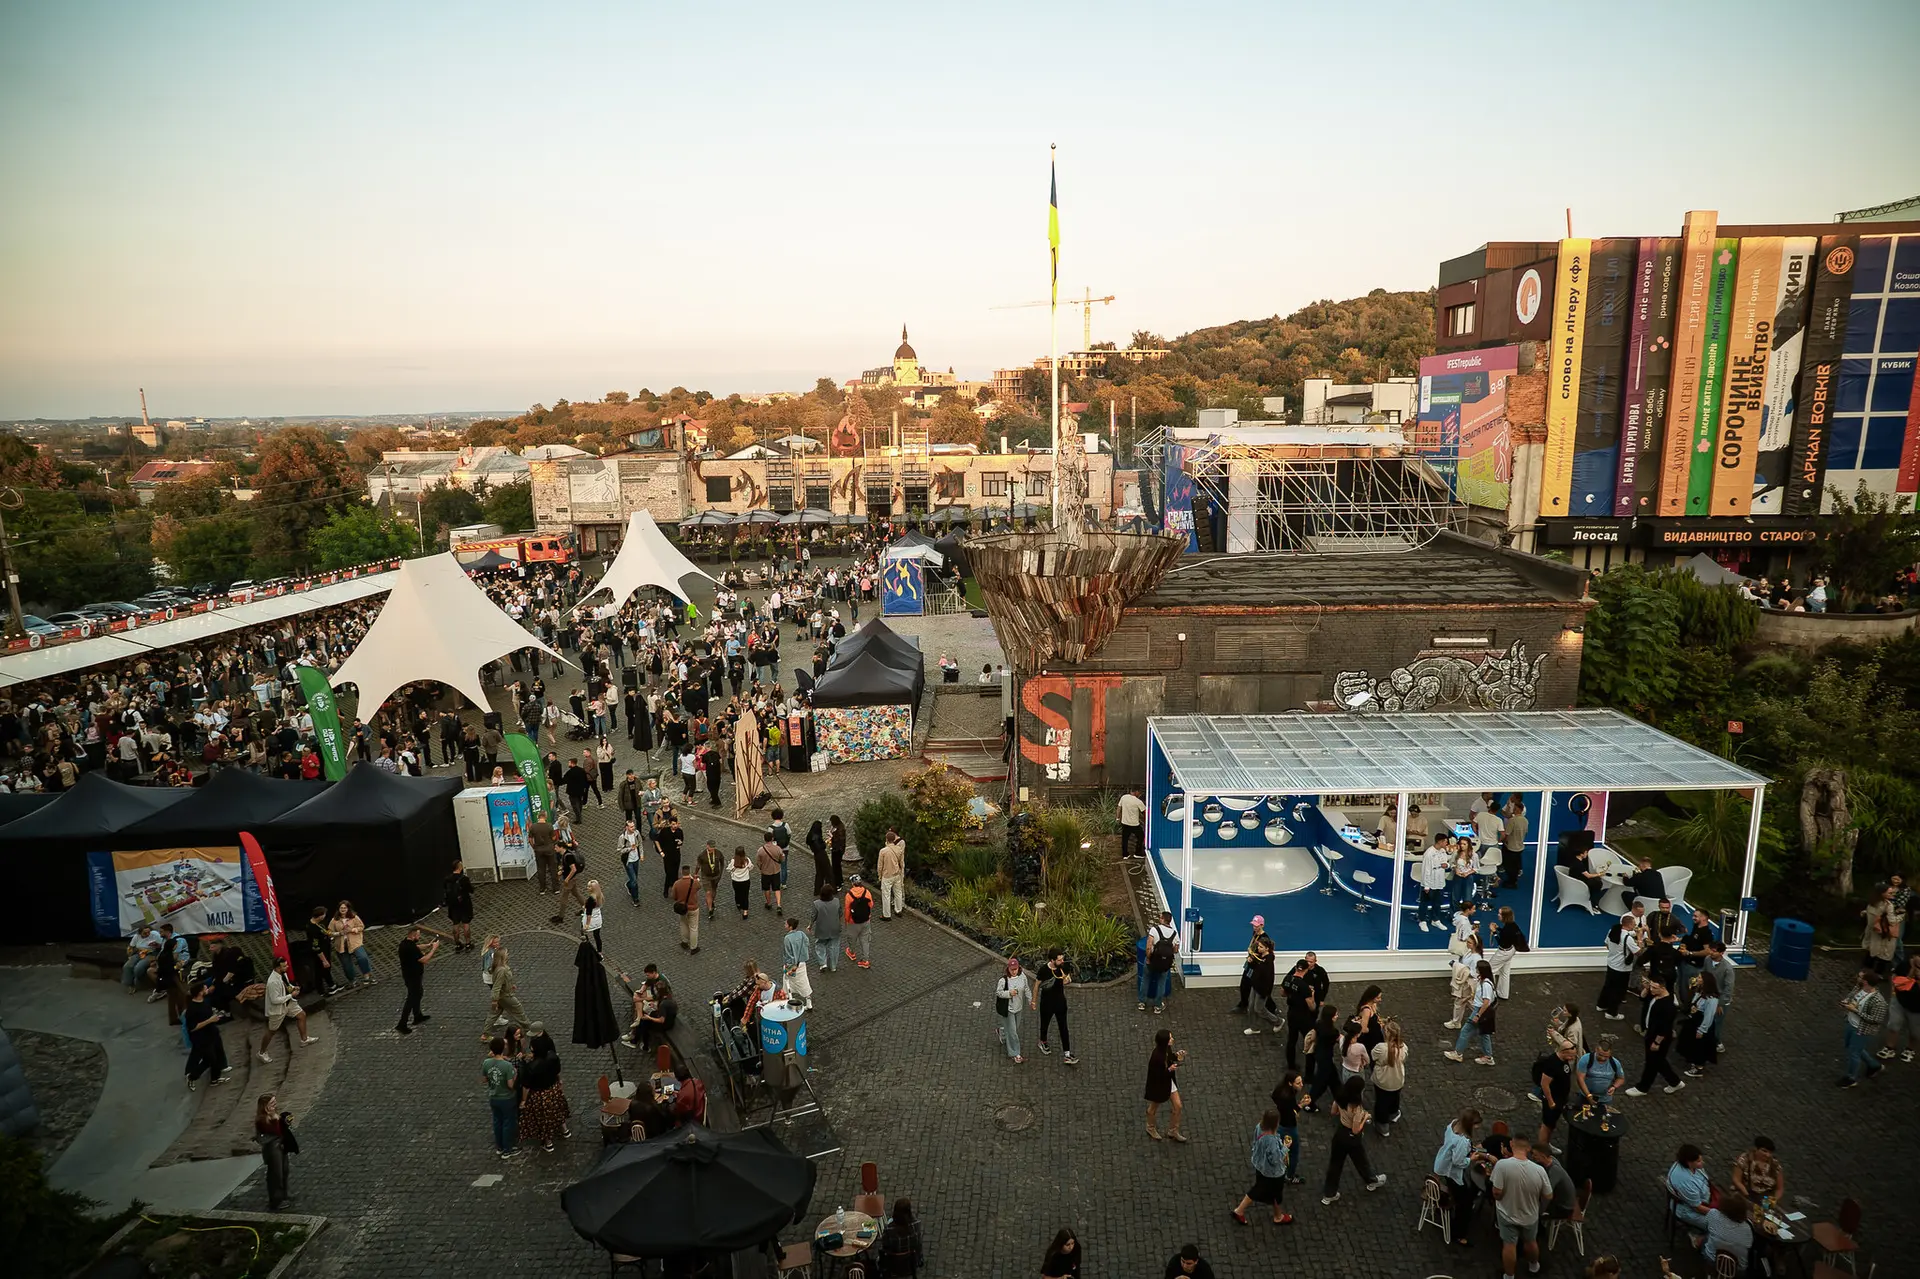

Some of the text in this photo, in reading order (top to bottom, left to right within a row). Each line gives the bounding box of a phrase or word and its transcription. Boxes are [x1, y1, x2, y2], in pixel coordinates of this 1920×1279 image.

[1639, 260, 1654, 321] еліс вокер
[1658, 256, 1672, 319] ірина ковбаса
[1785, 255, 1803, 309] ЖИВІ
[1894, 282, 1920, 290] Козло
[1896, 272, 1920, 280] Саша
[1565, 287, 1581, 333] літеру
[1745, 309, 1756, 340] Ентоні
[1564, 333, 1574, 354] на
[1561, 357, 1574, 400] слово
[1747, 320, 1770, 411] ВБИВСТВО
[1881, 361, 1911, 369] КУБИК
[1657, 388, 1667, 418] обійму
[1681, 378, 1694, 403] СЕБЕ
[1646, 414, 1653, 428] до
[1721, 355, 1753, 469] СОРОЧИНЕ
[1803, 364, 1831, 483] АРКАН ВОВКІВ
[1623, 403, 1640, 484] БАРВА ПУРПУРОВА
[1643, 428, 1652, 450] ходи
[1572, 531, 1618, 541] Леосад
[1663, 531, 1752, 544] ВИДАВНИЦТВО
[206, 910, 235, 927] МАПА
